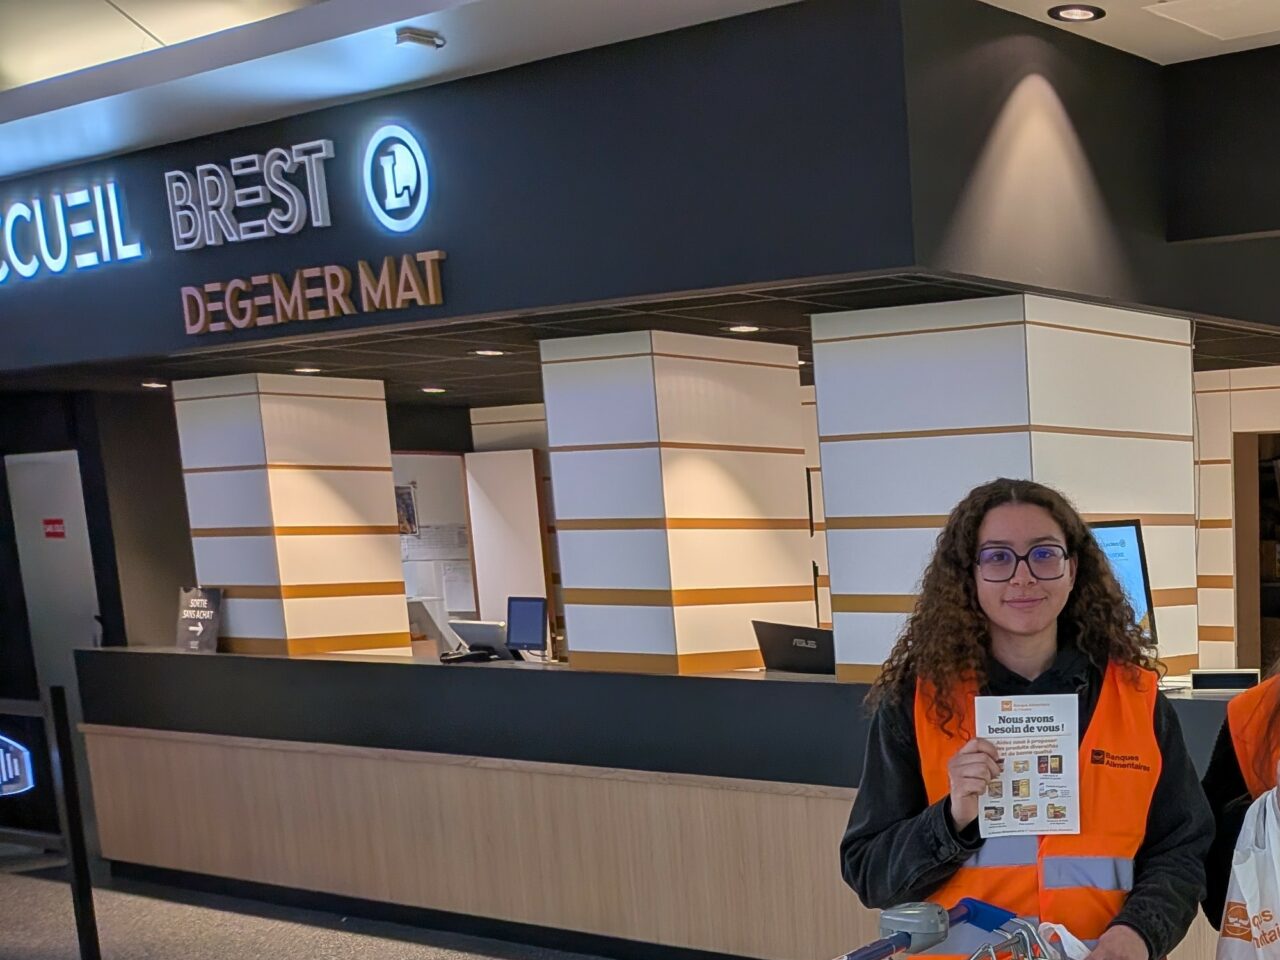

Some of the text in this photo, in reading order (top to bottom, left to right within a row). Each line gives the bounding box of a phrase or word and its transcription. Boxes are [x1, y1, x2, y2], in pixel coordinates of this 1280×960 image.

[165, 139, 334, 251] BREST
[0, 182, 141, 281] CUEIL
[181, 249, 447, 335] DEGEMER MAT
[189, 599, 208, 608] SORTIE
[182, 610, 214, 619] SANS ACHAT
[792, 638, 817, 649] ASUS
[998, 715, 1054, 724] Nous avons
[987, 725, 1021, 734] besoin
[1023, 724, 1035, 733] de
[1036, 724, 1060, 732] vous
[1105, 752, 1139, 761] Banques
[1105, 760, 1151, 771] Alimentaires
